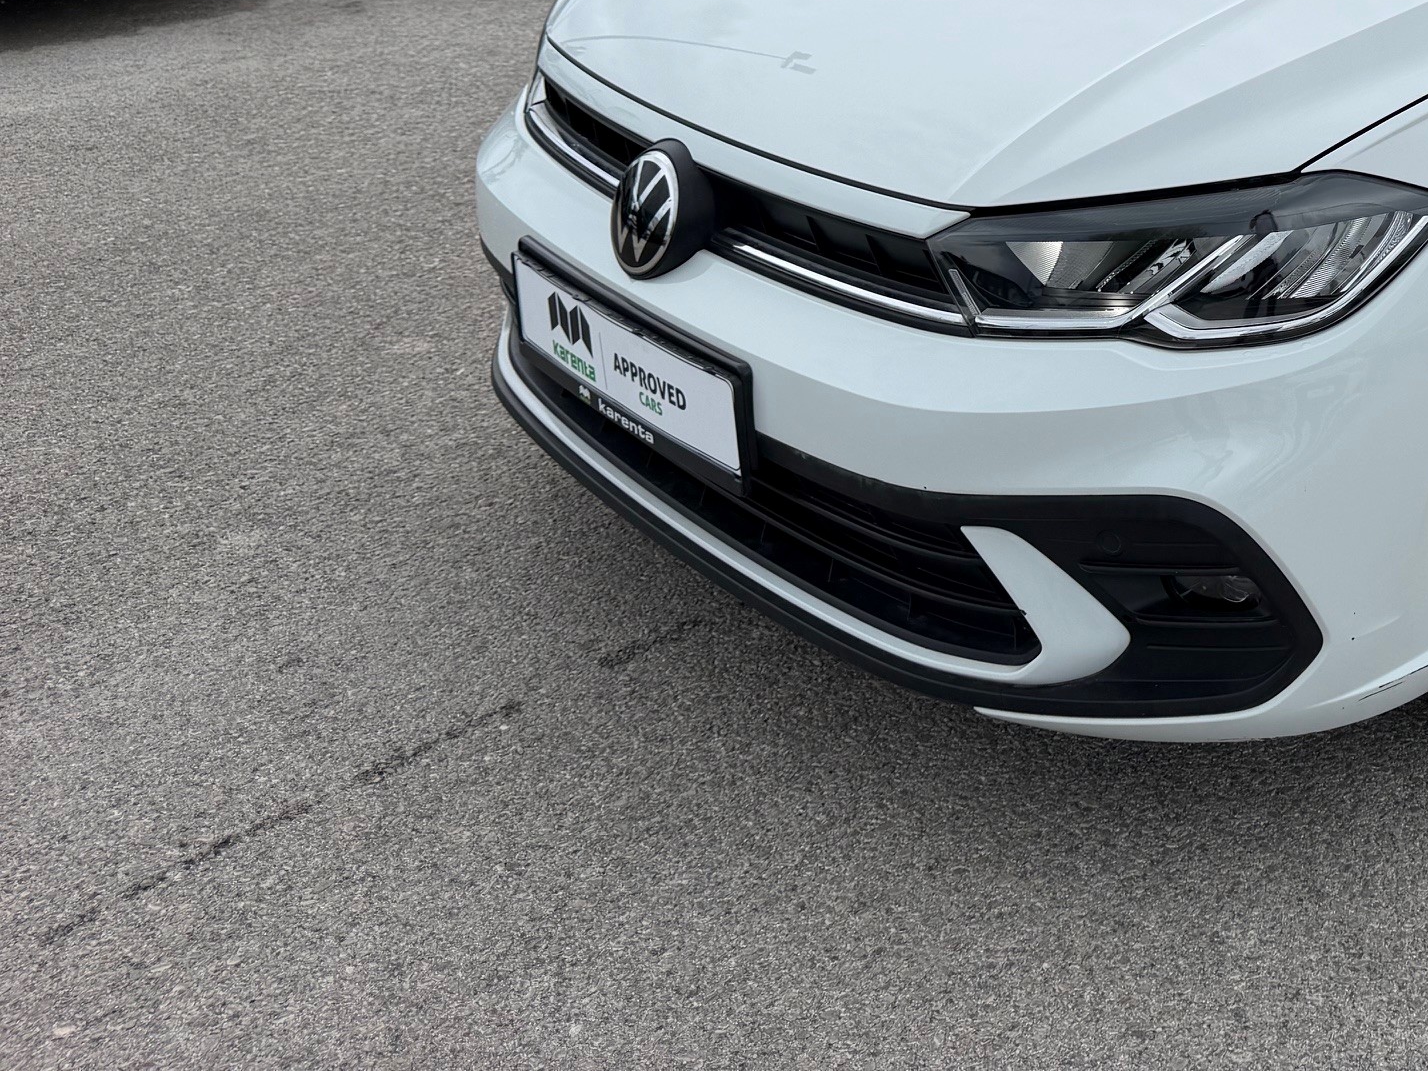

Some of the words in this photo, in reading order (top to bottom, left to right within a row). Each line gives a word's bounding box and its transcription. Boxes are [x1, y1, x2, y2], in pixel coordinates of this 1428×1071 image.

[613, 352, 687, 411] APPROVED
[639, 391, 663, 416] CARS
[598, 397, 655, 444] karenta
